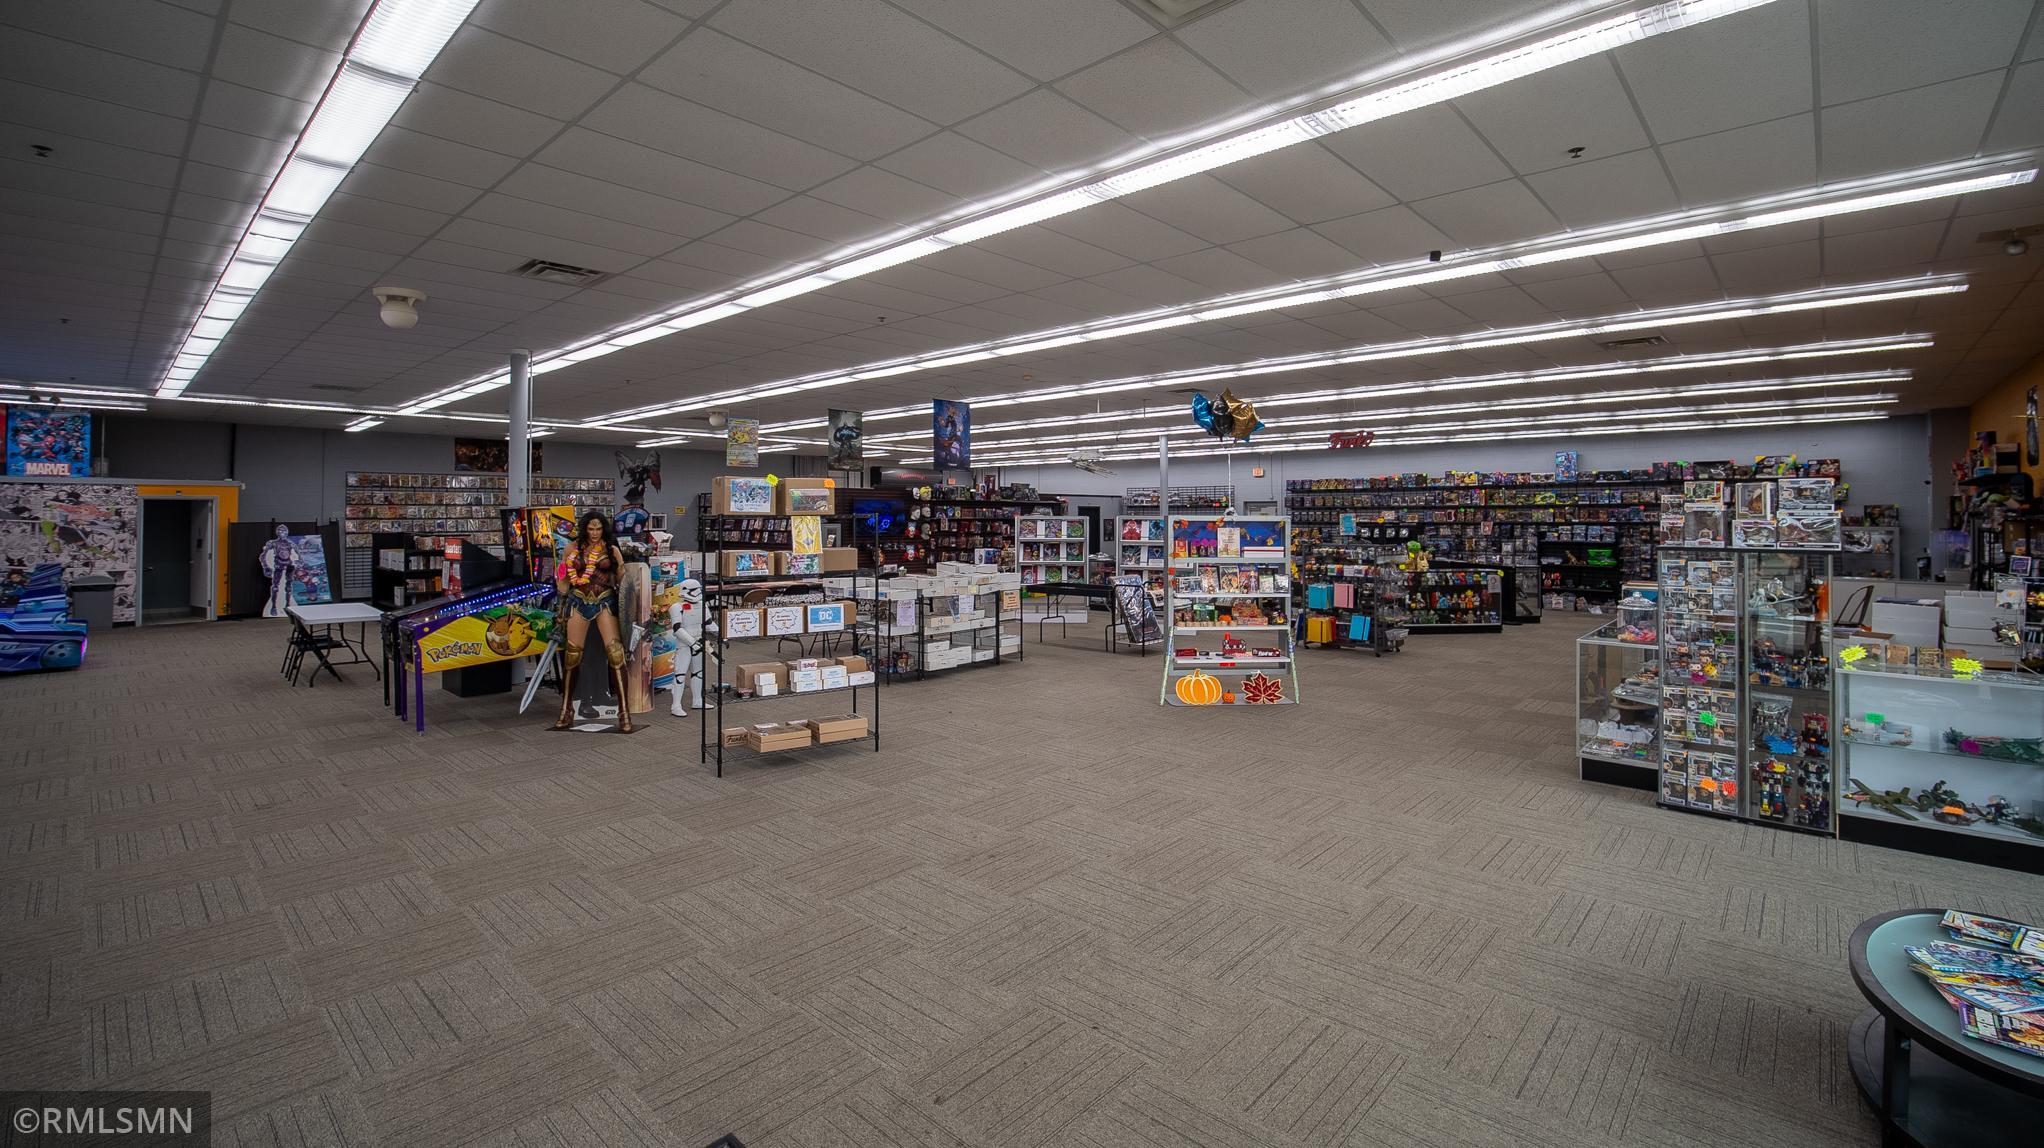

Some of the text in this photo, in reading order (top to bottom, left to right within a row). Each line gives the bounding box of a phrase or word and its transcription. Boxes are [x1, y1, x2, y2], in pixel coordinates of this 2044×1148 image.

[26, 463, 70, 475] MARVEL
[819, 611, 832, 620] DC
[426, 640, 482, 663] Pokémon
